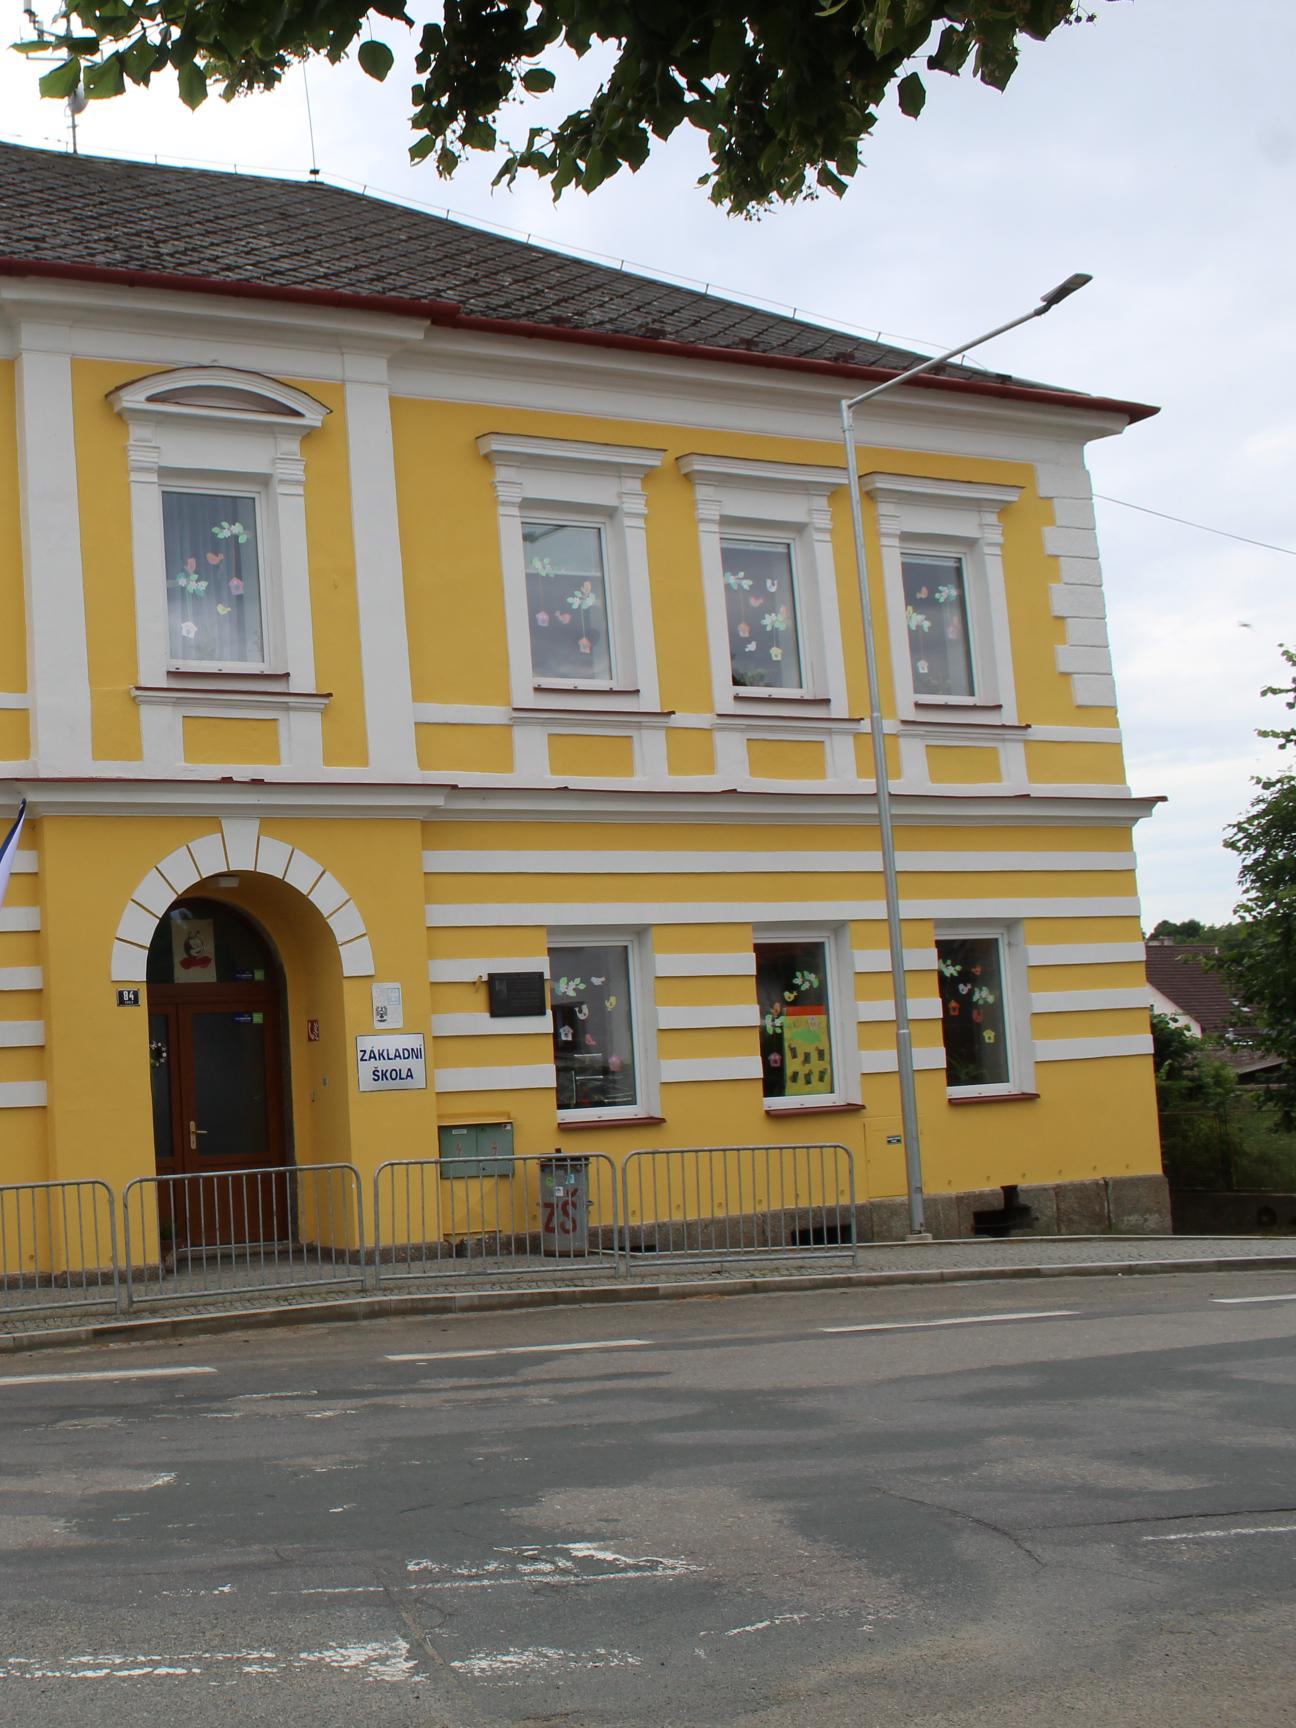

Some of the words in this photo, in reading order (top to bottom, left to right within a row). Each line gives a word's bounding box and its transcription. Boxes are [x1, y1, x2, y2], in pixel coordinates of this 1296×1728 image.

[359, 1044, 423, 1062] ZÁKLADNÍ
[372, 1066, 414, 1082] ŠKOLA
[543, 1188, 578, 1234] ZŠ
